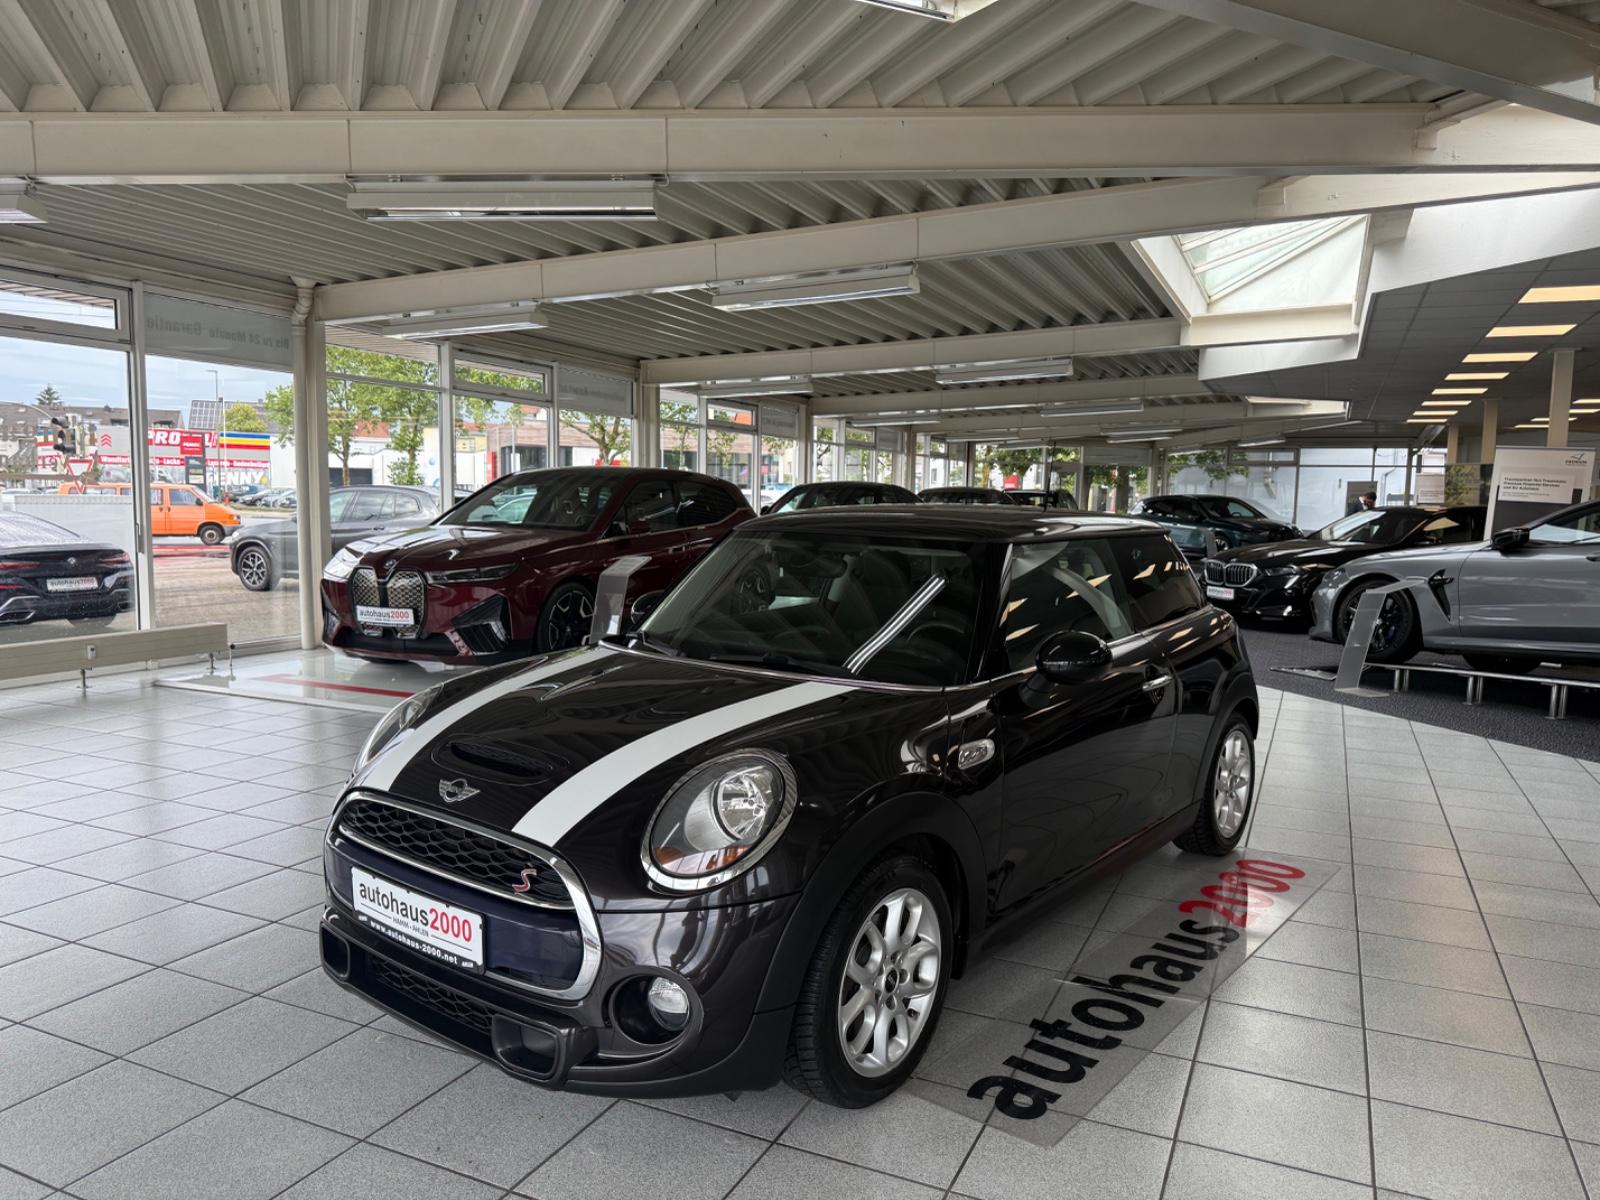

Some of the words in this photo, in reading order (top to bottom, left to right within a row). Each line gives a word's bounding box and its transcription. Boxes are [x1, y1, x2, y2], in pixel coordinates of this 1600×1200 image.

[359, 609, 410, 619] autohaus2000
[359, 882, 473, 942] autohaus2000
[370, 920, 458, 965] www.autohaus-2000.net
[966, 859, 1306, 1120] autohaus2000
